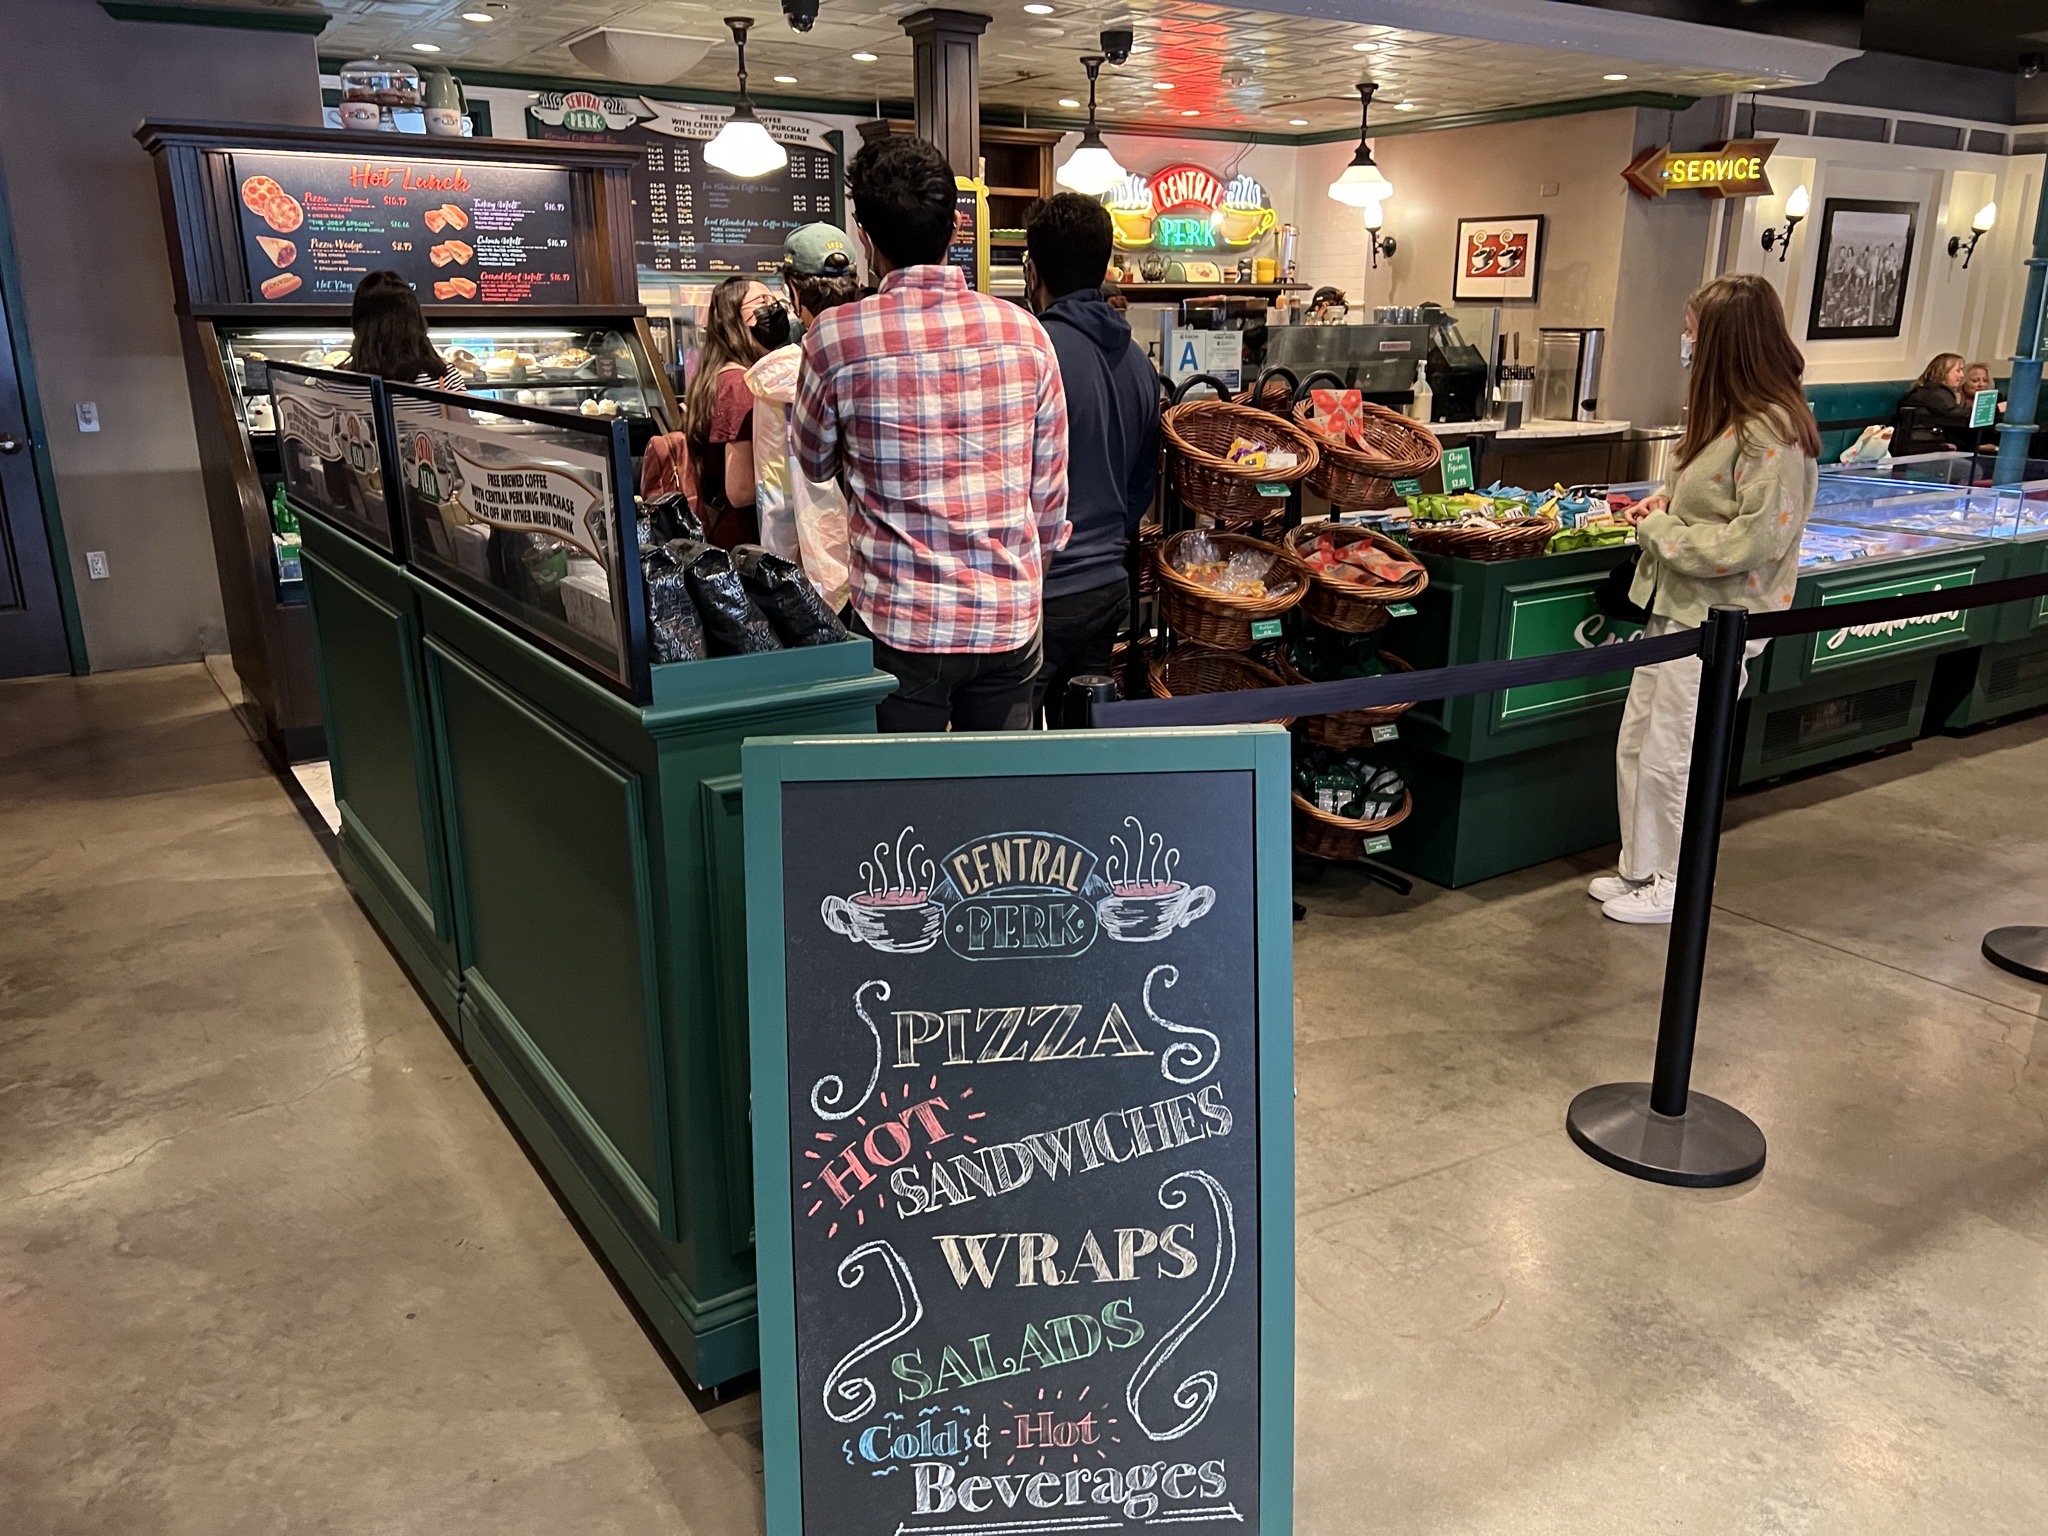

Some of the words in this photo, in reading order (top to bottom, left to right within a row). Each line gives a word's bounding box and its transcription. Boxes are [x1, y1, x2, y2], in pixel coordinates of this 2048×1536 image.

[565, 94, 600, 112] CENTRAL
[700, 114, 718, 122] FREE
[758, 116, 782, 124] OFFEE
[570, 112, 600, 129] PERK
[671, 118, 692, 128] WITH
[694, 120, 724, 130] CENTRA
[771, 124, 811, 135] PURCHASE
[698, 129, 712, 137] OFF
[783, 133, 808, 142] DRINK
[349, 162, 405, 189] Hot
[402, 166, 472, 193] Lunch
[1672, 157, 1761, 183] SERVICE
[303, 191, 329, 203] Pizza
[1158, 170, 1225, 209] CENTRAL
[1161, 217, 1216, 247] PERK
[1179, 341, 1199, 371] A
[487, 473, 500, 488] FREE
[500, 473, 524, 488] BREWED
[524, 473, 548, 489] COFFEE
[470, 482, 485, 501] WITH
[484, 488, 509, 505] CENTRAL
[508, 490, 524, 505] PERK
[523, 490, 539, 506] MUG
[539, 491, 575, 516] PURCHASE
[474, 499, 482, 515] OR
[482, 502, 489, 518] $2
[489, 505, 500, 520] OFF
[500, 507, 512, 522] ANY
[512, 509, 533, 524] OTHER
[532, 510, 551, 527] MENU
[551, 512, 575, 536] DRINK
[952, 838, 1084, 895] CENTRAL
[965, 903, 1079, 951] PERK
[891, 1002, 1155, 1069] PIZZA
[817, 1096, 955, 1209] HOT
[889, 1082, 1234, 1219] SANDWICHES
[931, 1222, 1200, 1291] WRAPS
[891, 1296, 1145, 1403] SALADS
[858, 1418, 963, 1464] Cold
[973, 1413, 992, 1460] &
[1014, 1410, 1101, 1449] Hot
[910, 1457, 1228, 1521] Beverages
